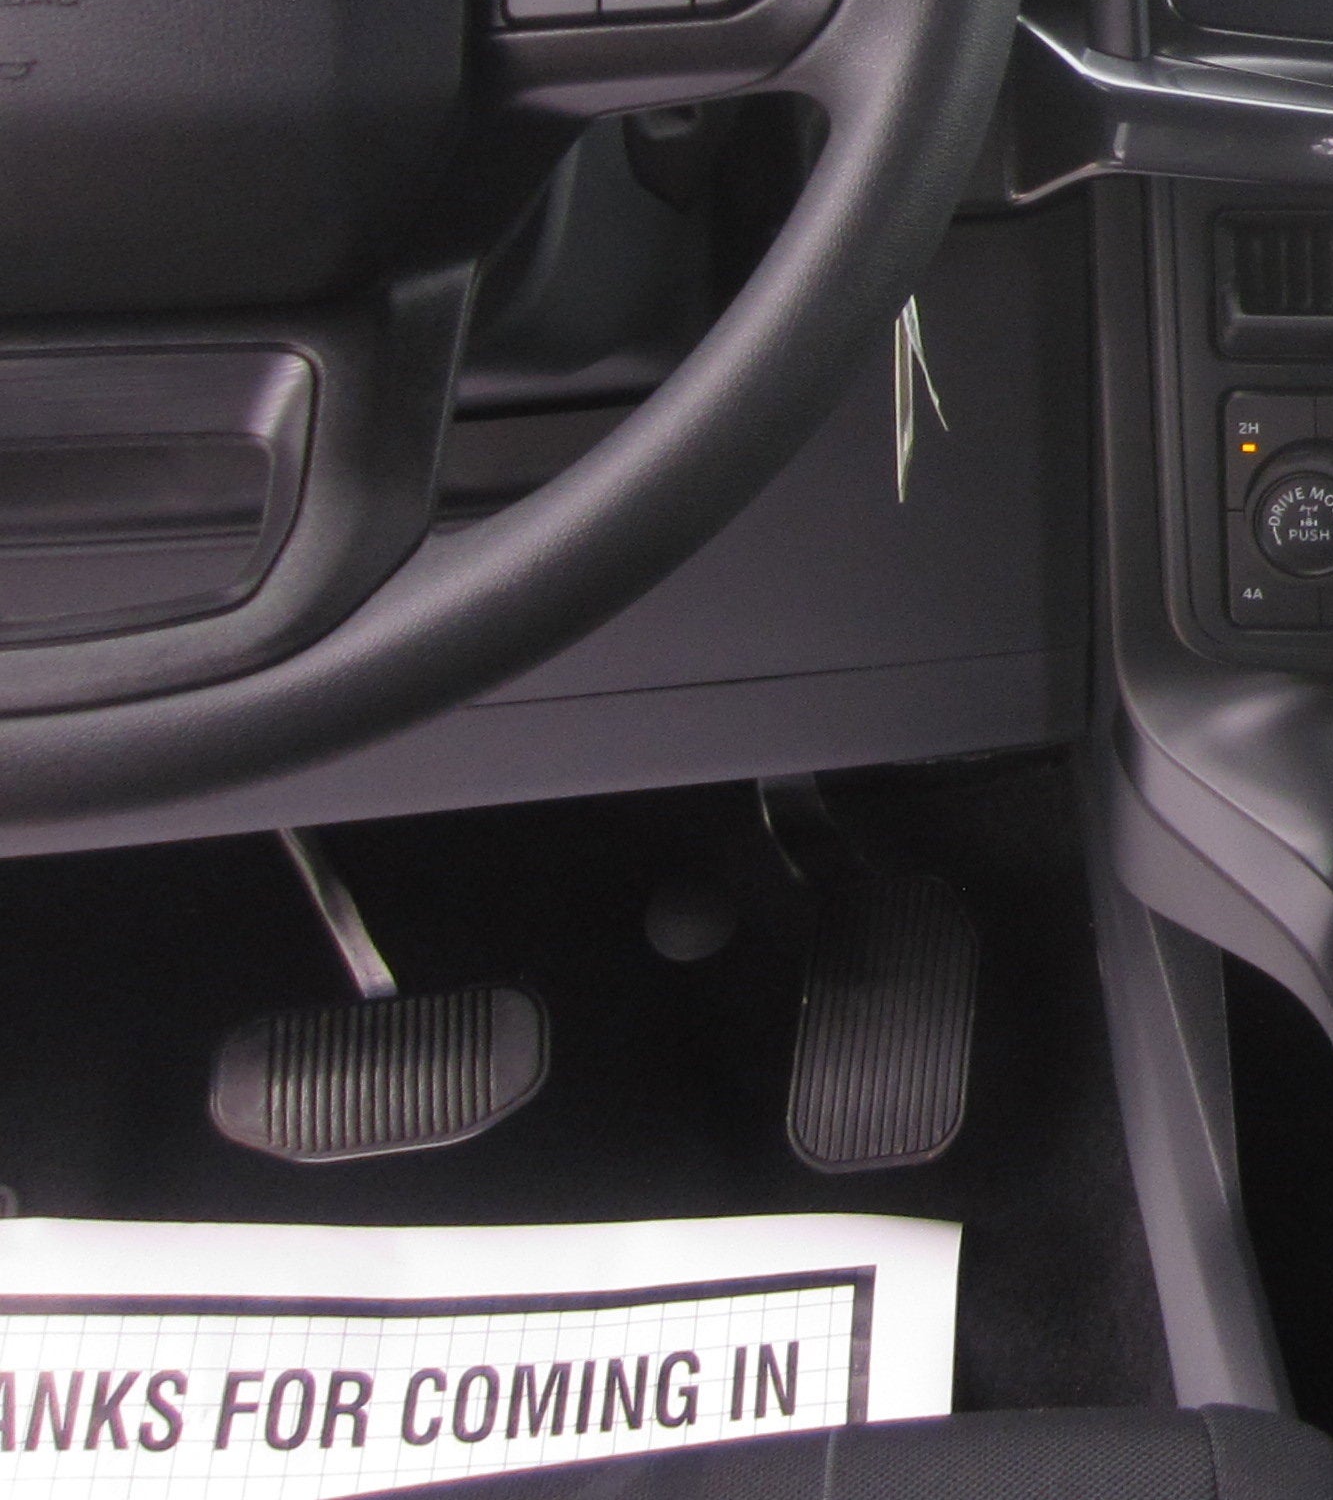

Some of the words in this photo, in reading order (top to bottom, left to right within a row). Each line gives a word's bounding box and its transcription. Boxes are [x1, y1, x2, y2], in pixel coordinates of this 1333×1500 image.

[1238, 422, 1259, 435] 2H
[1268, 487, 1305, 527] DRIVE
[1288, 528, 1331, 542] PUSH
[1242, 587, 1263, 600] 4A
[213, 1368, 372, 1452] FOR
[402, 1349, 699, 1447] COMING
[729, 1340, 801, 1422] IN
